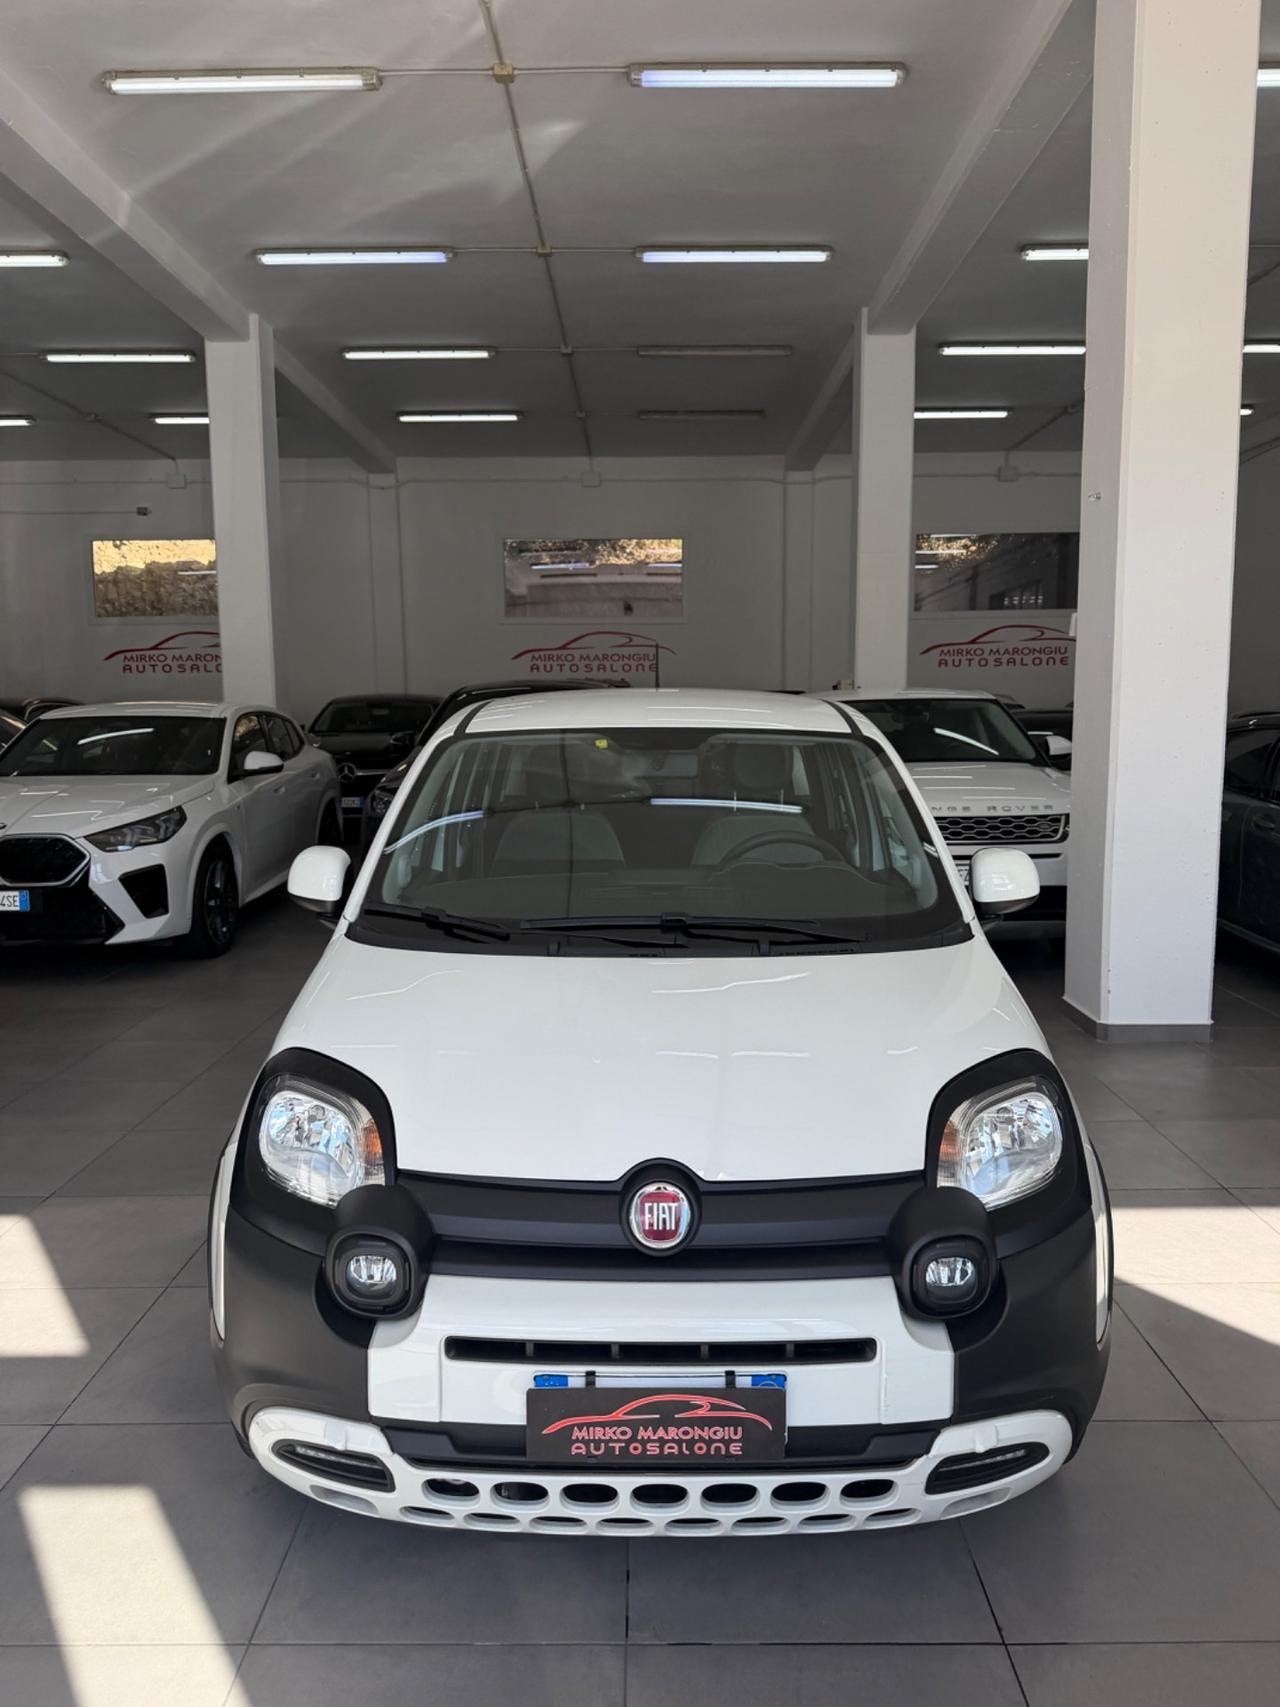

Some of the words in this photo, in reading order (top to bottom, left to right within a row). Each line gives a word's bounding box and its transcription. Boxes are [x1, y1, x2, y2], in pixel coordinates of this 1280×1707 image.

[939, 647, 985, 657] MIRKO
[988, 646, 1068, 656] MARONGIU
[123, 653, 167, 663] MIRKO
[530, 653, 575, 662] MIRKO
[579, 653, 656, 662] MARONGIU
[938, 656, 1069, 668] AUTOSALONE
[530, 663, 657, 673] AUTOSALONE
[987, 804, 1054, 812] ROVER
[644, 1202, 678, 1231] FIAT
[571, 1426, 632, 1440] MIRKO
[637, 1426, 743, 1440] MARONGIU
[570, 1442, 743, 1456] AUTOSALONE
